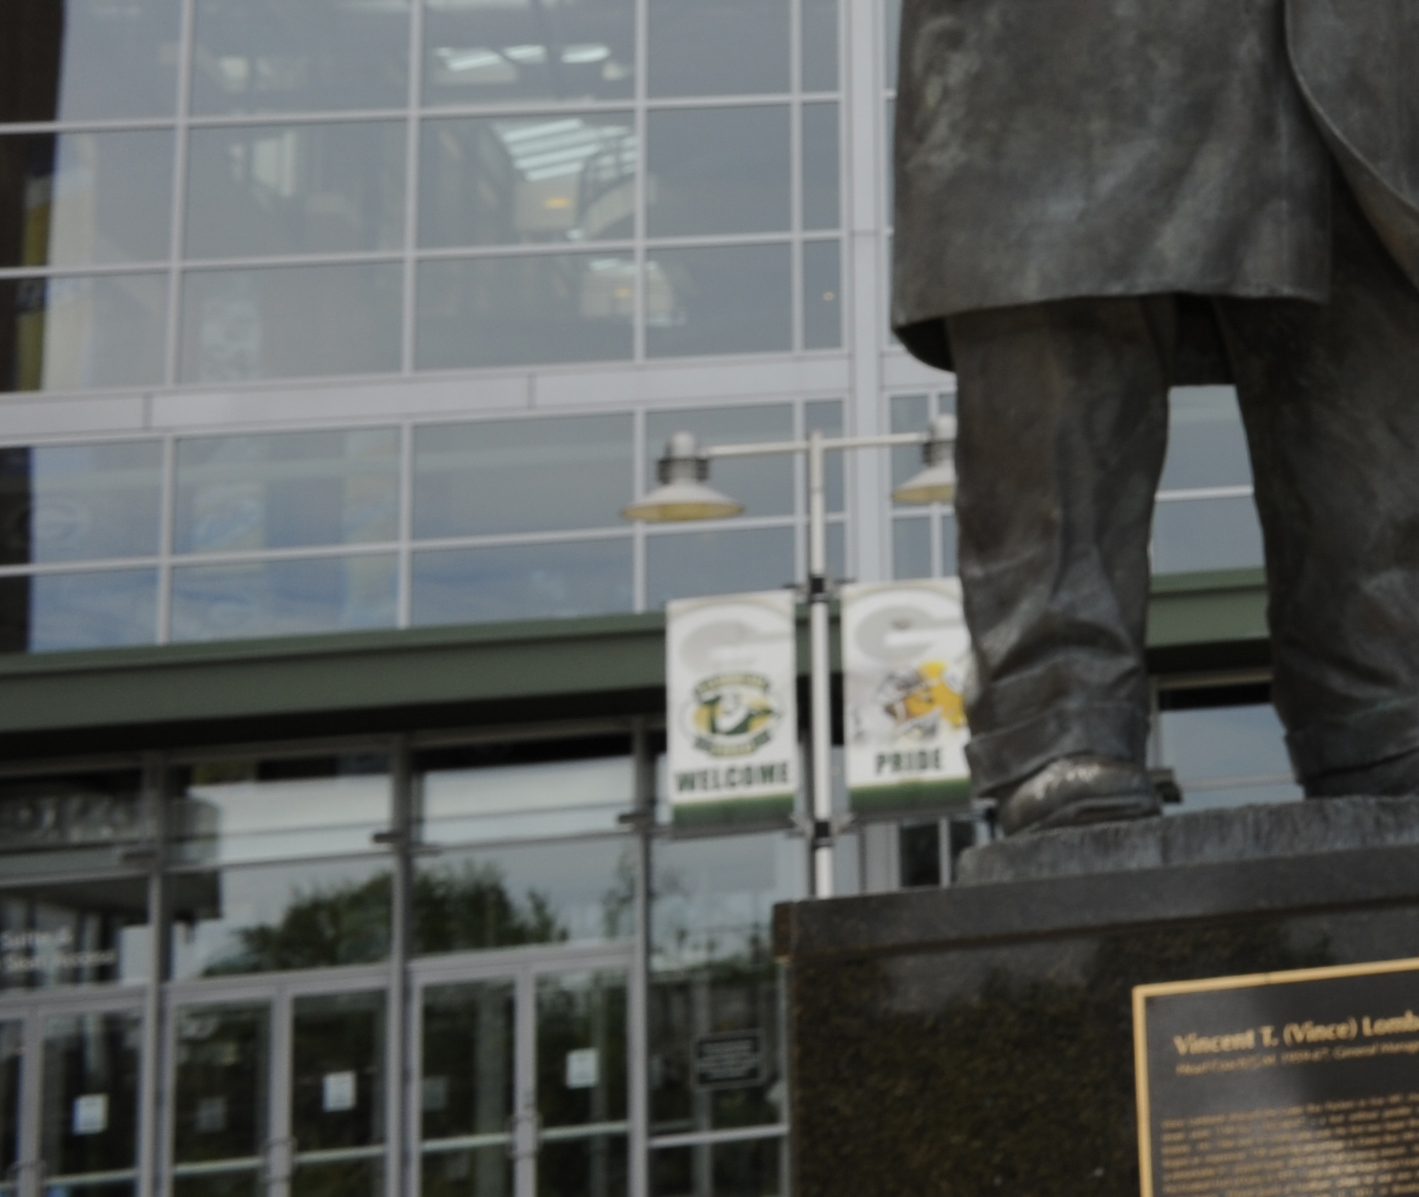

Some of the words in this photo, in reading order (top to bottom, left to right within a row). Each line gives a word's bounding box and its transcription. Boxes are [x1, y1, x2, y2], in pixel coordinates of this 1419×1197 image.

[674, 760, 789, 793] WELCOME
[875, 747, 943, 774] PRIDE
[1173, 1031, 1256, 1056] Vincent
[1260, 1024, 1279, 1048] T.
[1283, 1015, 1358, 1048] (Vince)
